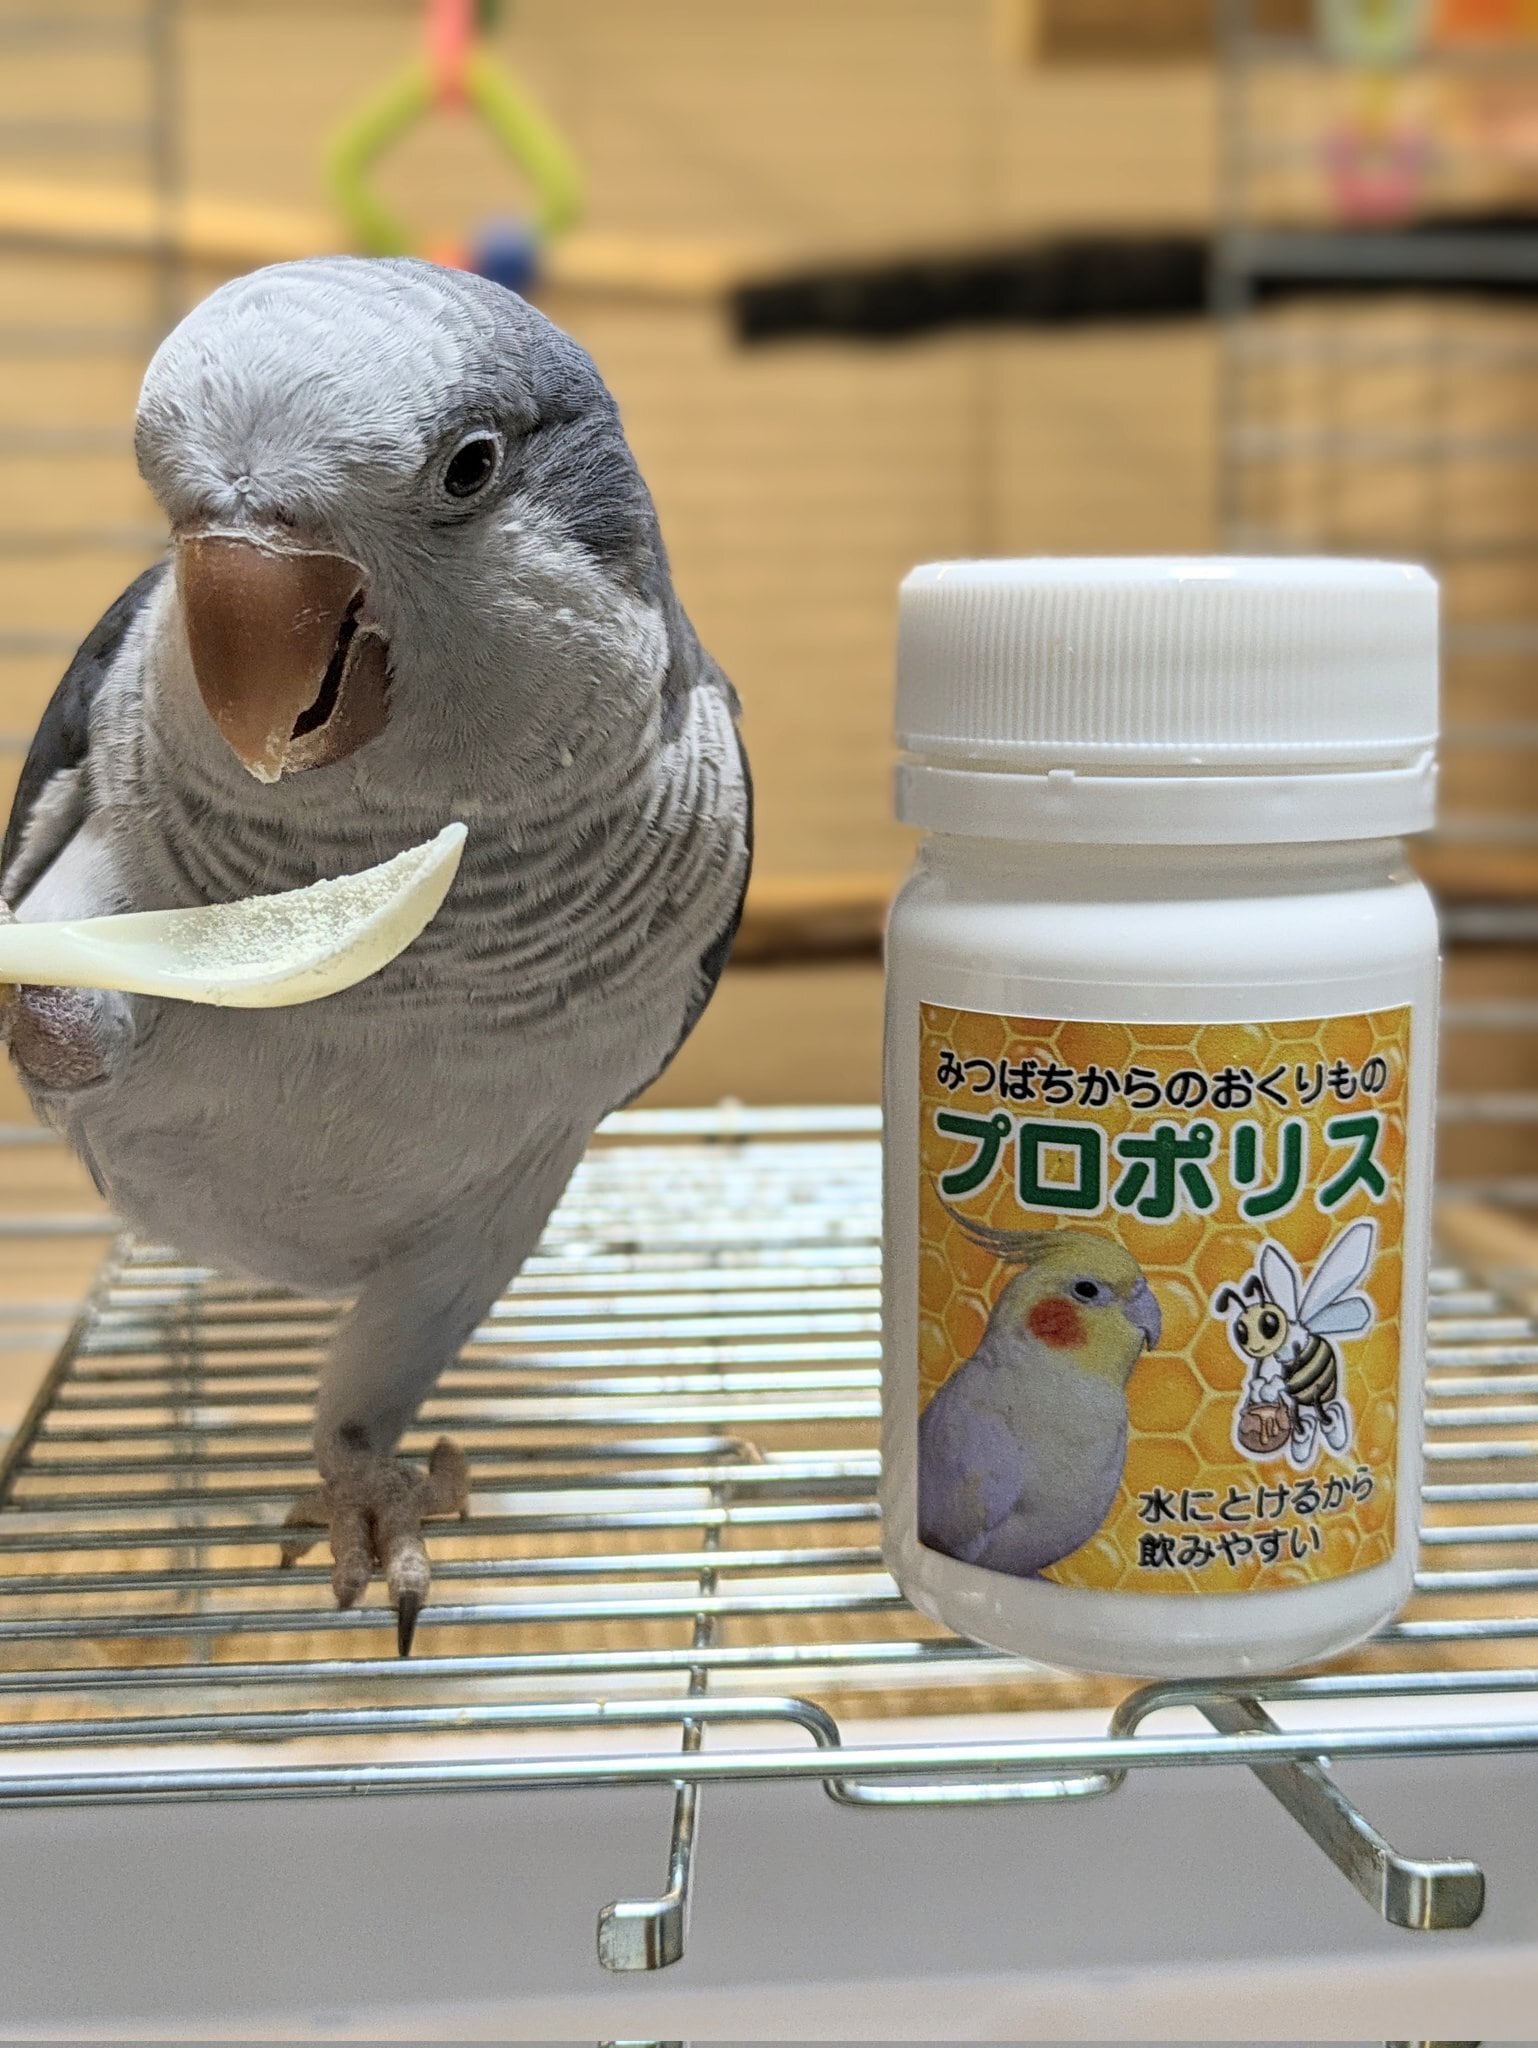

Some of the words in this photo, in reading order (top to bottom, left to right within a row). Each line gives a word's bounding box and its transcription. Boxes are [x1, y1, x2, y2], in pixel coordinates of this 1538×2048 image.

[937, 1051, 1387, 1109] みつばちからのおくりもの
[936, 1112, 1386, 1219] プロポリス
[1137, 1466, 1374, 1523] 水にとけるから
[1137, 1525, 1320, 1568] 飲みやすい
